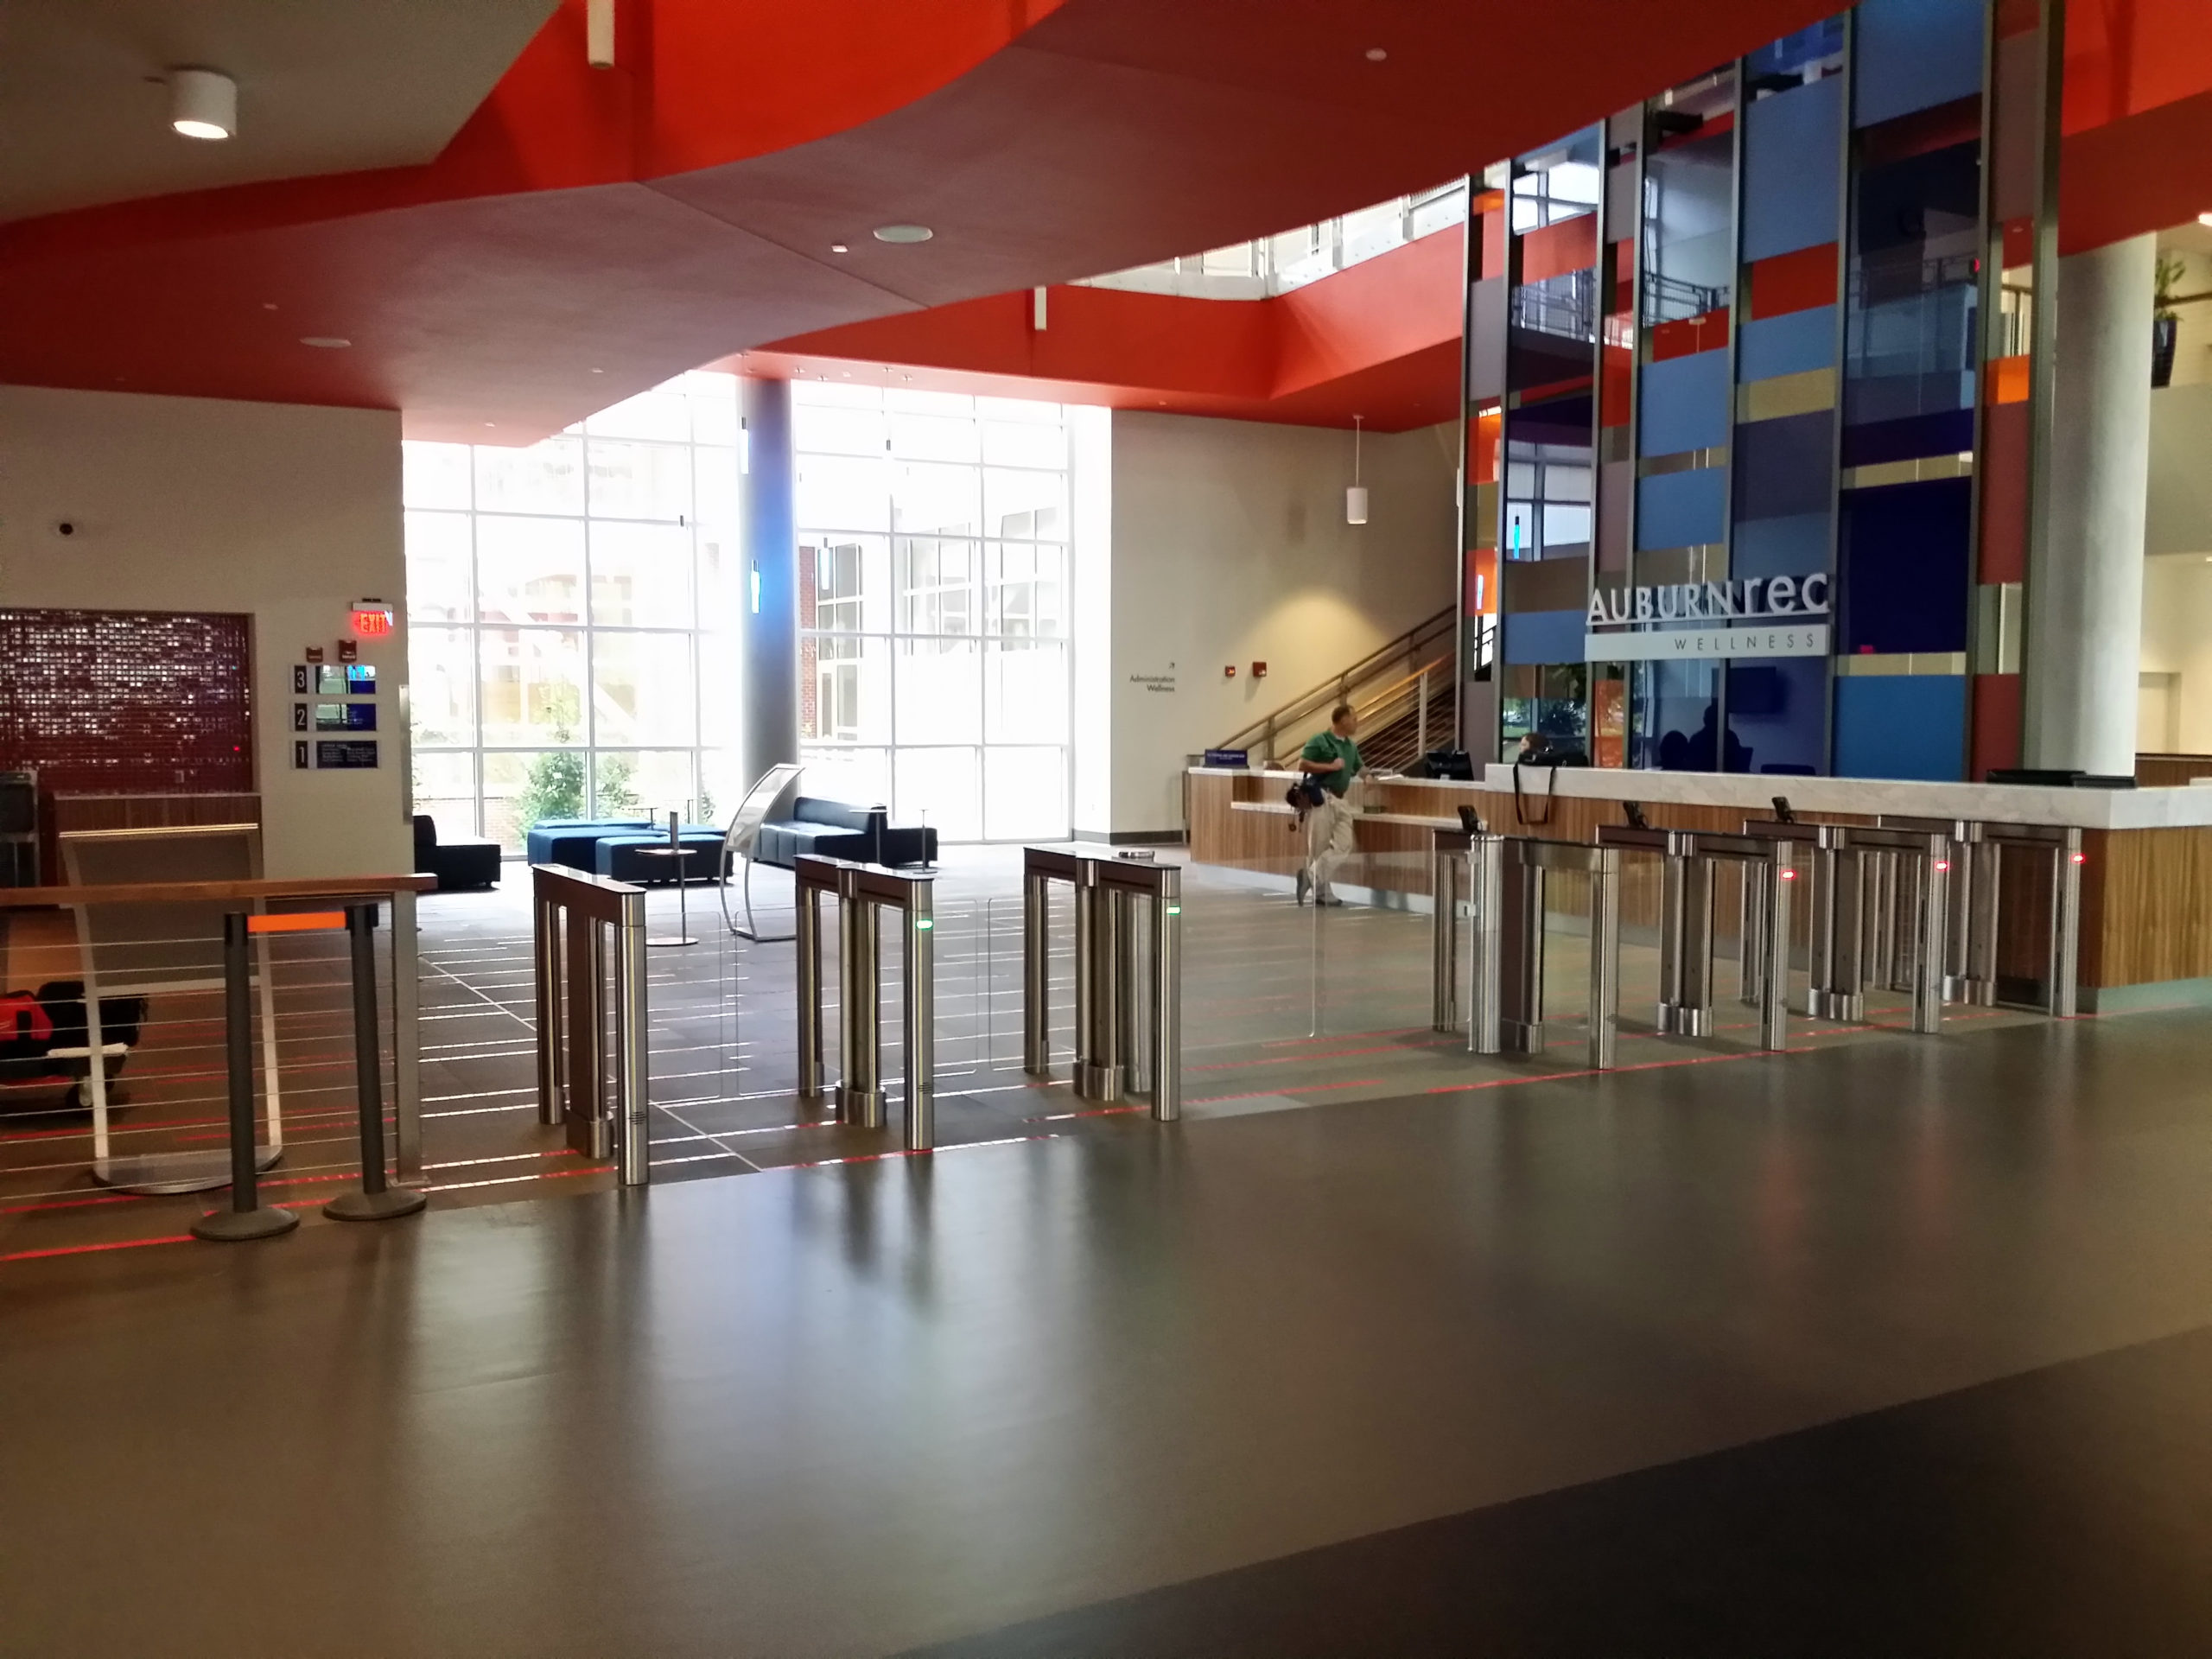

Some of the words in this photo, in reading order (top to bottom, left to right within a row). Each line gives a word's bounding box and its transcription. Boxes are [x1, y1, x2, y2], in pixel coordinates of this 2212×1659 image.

[359, 613, 385, 633] EXIT
[1675, 633, 1815, 651] WELLNESS
[297, 671, 305, 689] 3
[297, 709, 306, 726] 2
[299, 747, 305, 763] 1
